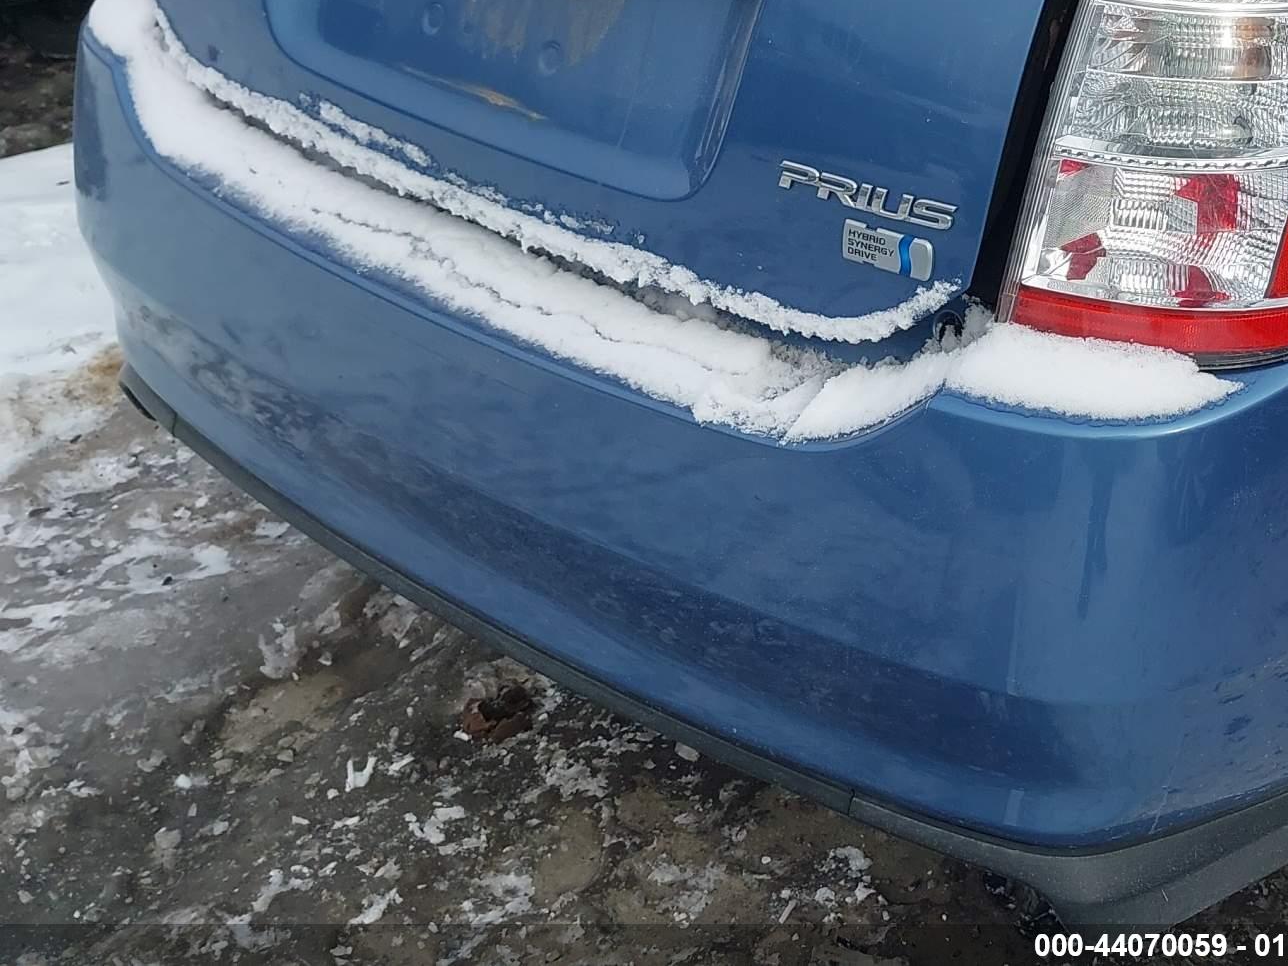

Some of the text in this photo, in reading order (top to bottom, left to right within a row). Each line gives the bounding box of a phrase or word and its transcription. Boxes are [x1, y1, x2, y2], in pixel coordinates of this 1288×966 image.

[778, 160, 959, 230] PRIUS
[848, 228, 886, 246] HYBRID
[847, 237, 895, 257] SYNERGY
[847, 247, 877, 261] DRIVE
